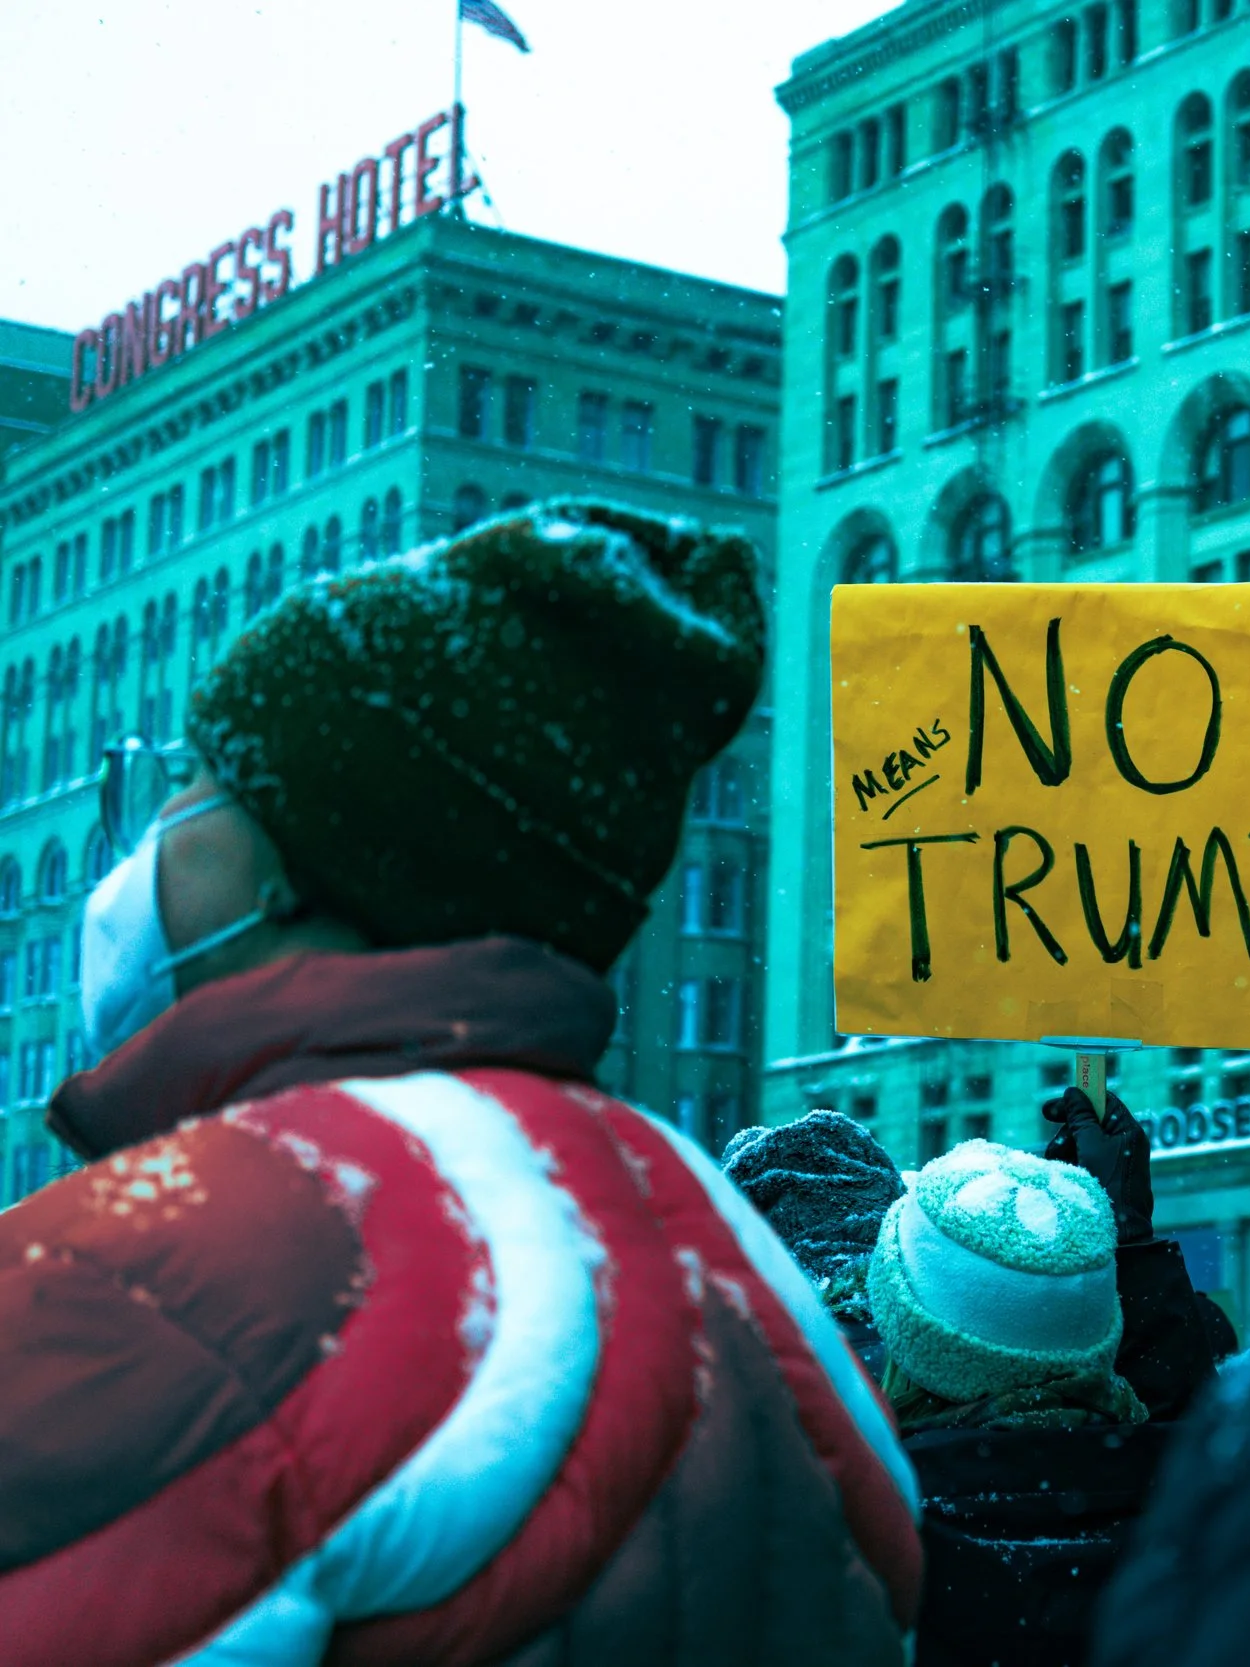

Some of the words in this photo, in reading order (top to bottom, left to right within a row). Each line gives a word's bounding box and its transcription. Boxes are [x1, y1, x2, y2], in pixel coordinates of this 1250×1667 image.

[69, 207, 295, 414] CONGRESS
[313, 101, 482, 278] HOTEL
[851, 719, 952, 812] MEANS
[964, 617, 1223, 796] NO
